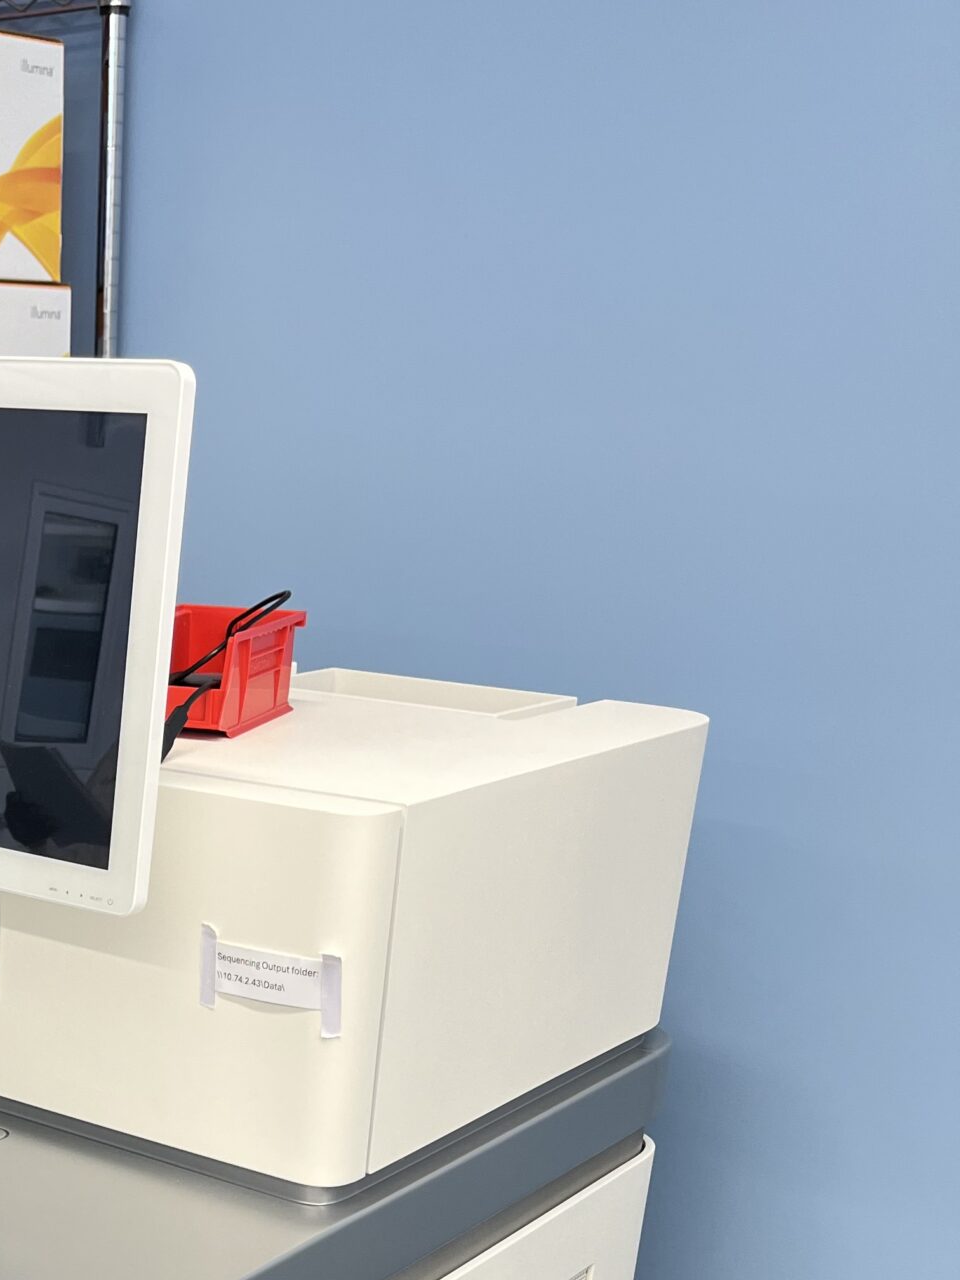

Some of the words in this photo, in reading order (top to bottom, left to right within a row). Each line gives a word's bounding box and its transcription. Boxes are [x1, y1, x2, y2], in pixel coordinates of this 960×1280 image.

[21, 58, 54, 78] illumina
[30, 305, 61, 321] illumina
[217, 951, 261, 970] Sequencing
[261, 961, 291, 974] Output
[291, 966, 320, 979] folder:
